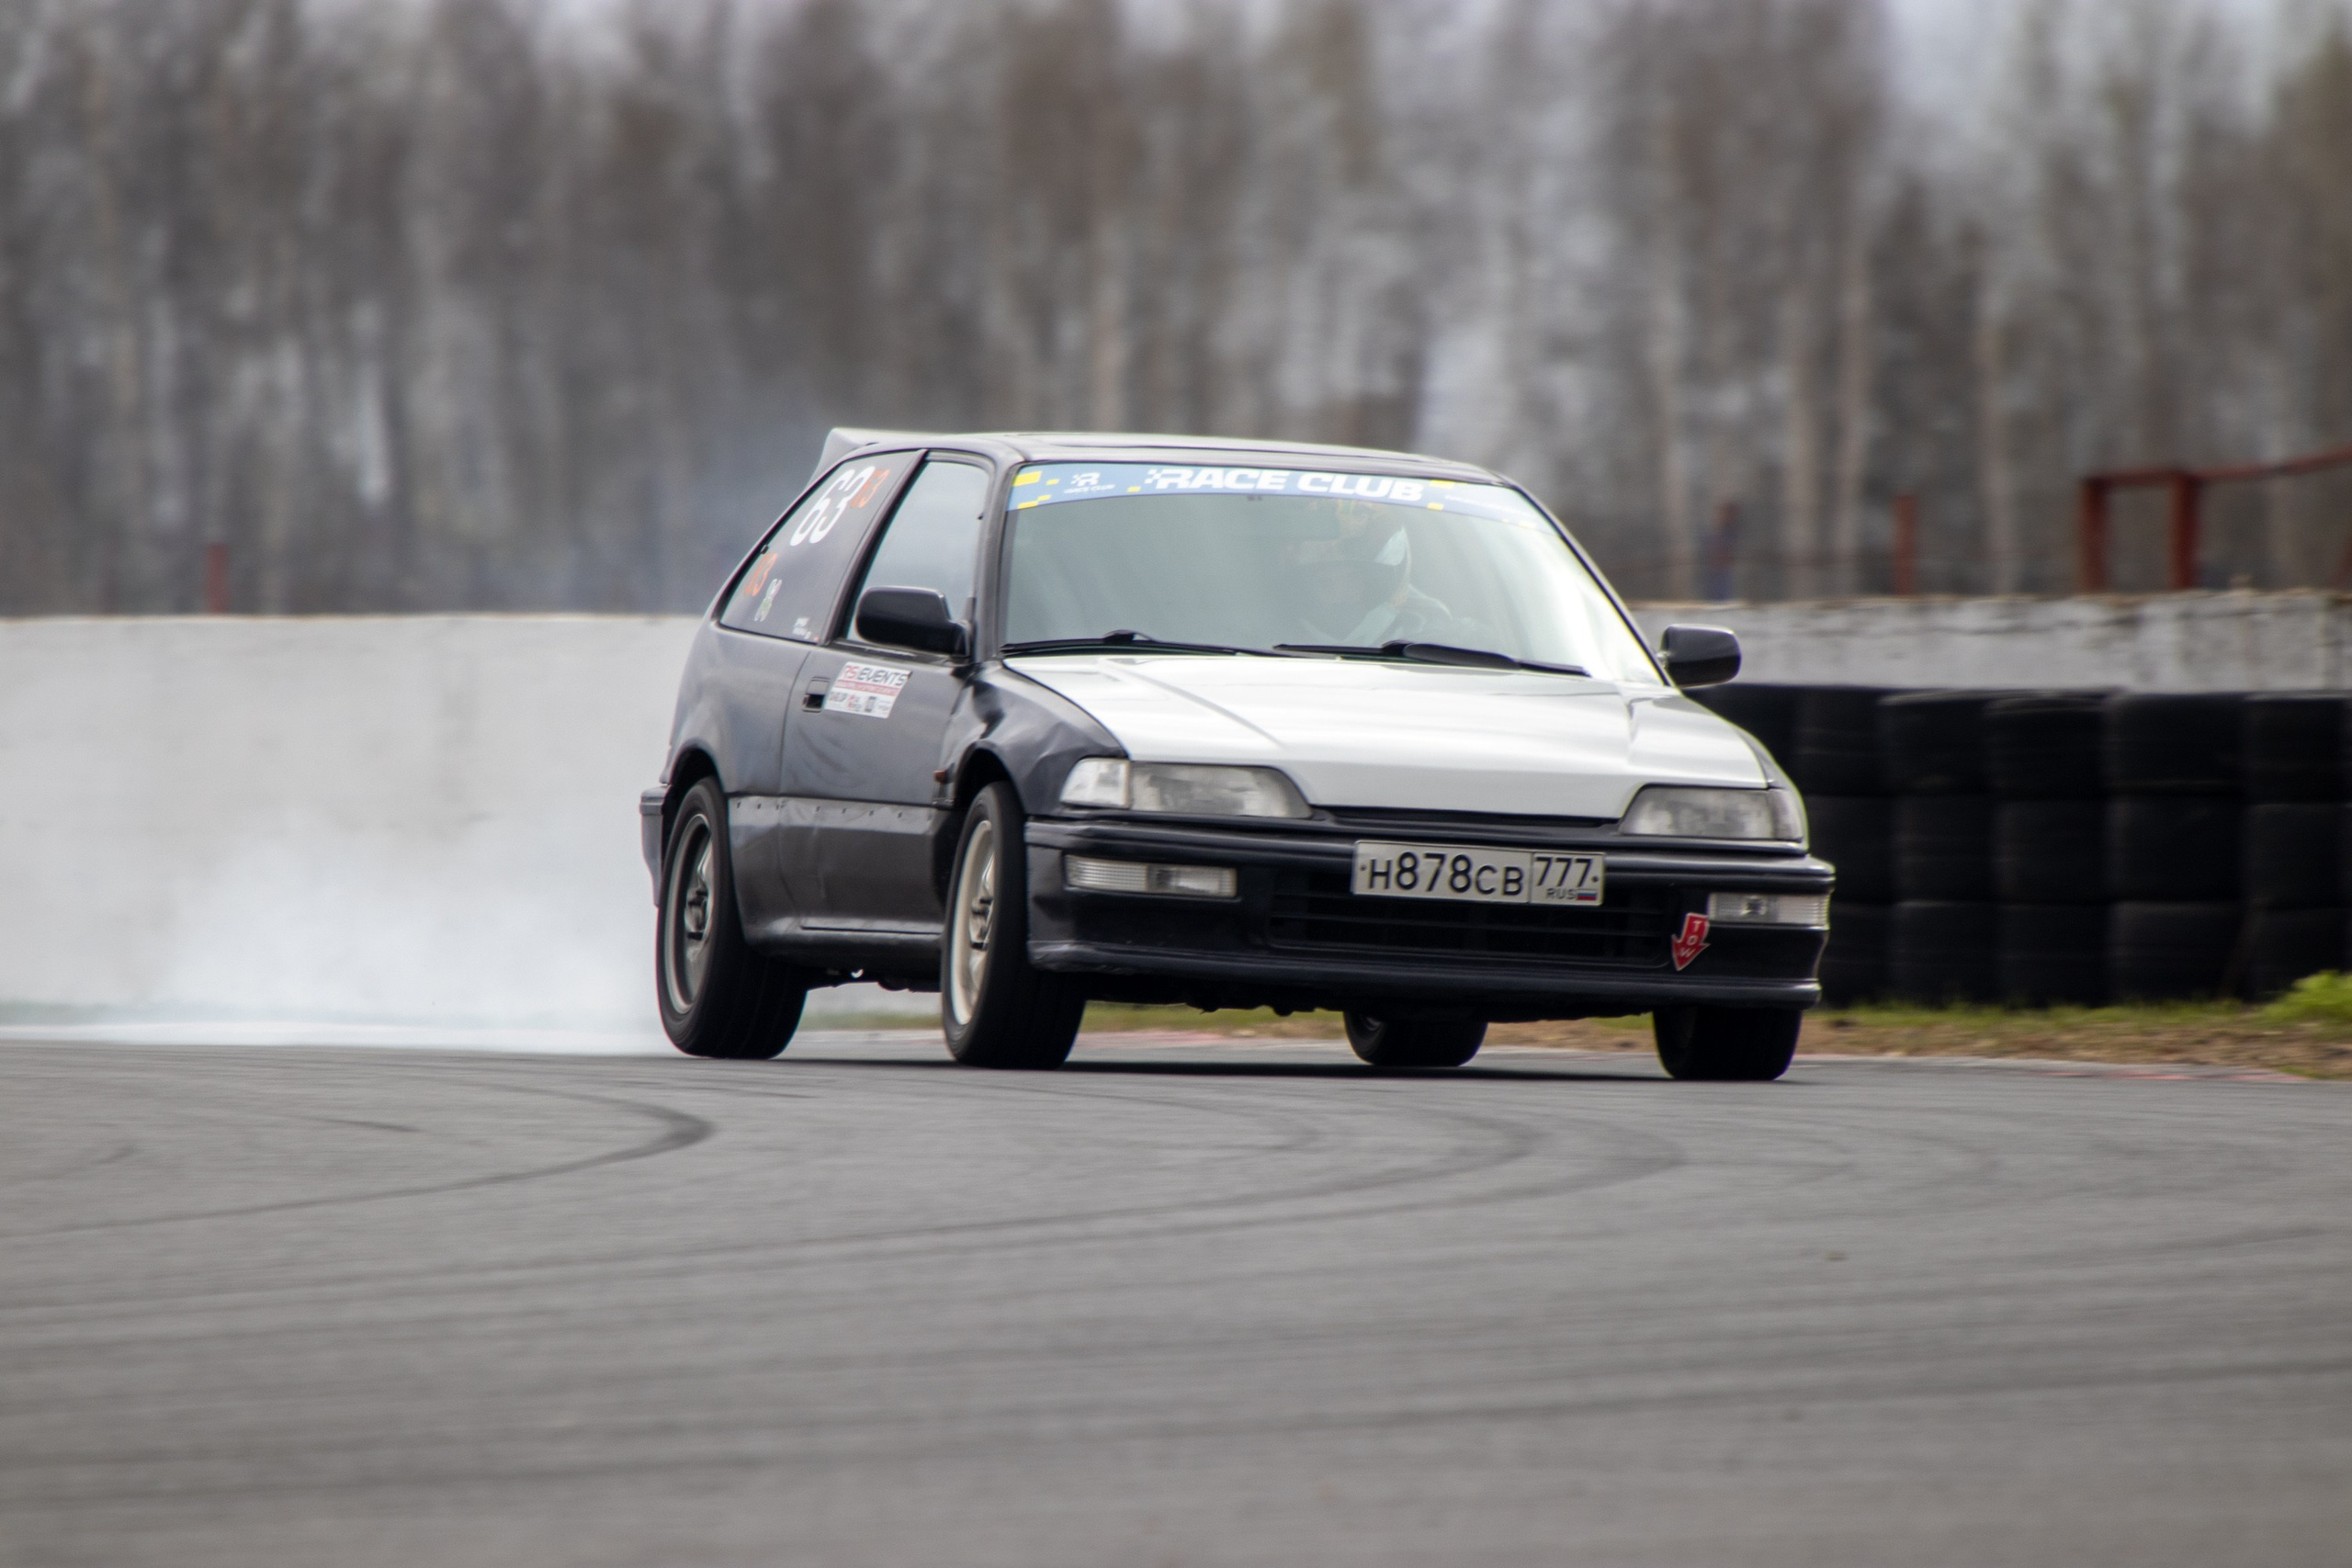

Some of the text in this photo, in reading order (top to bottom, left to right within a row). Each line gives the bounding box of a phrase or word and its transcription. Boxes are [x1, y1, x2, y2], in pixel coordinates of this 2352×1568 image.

[1148, 468, 1424, 502] RACE CLUB
[790, 466, 876, 547] 63
[1534, 856, 1593, 888] 777
[1545, 887, 1576, 900] RUS
